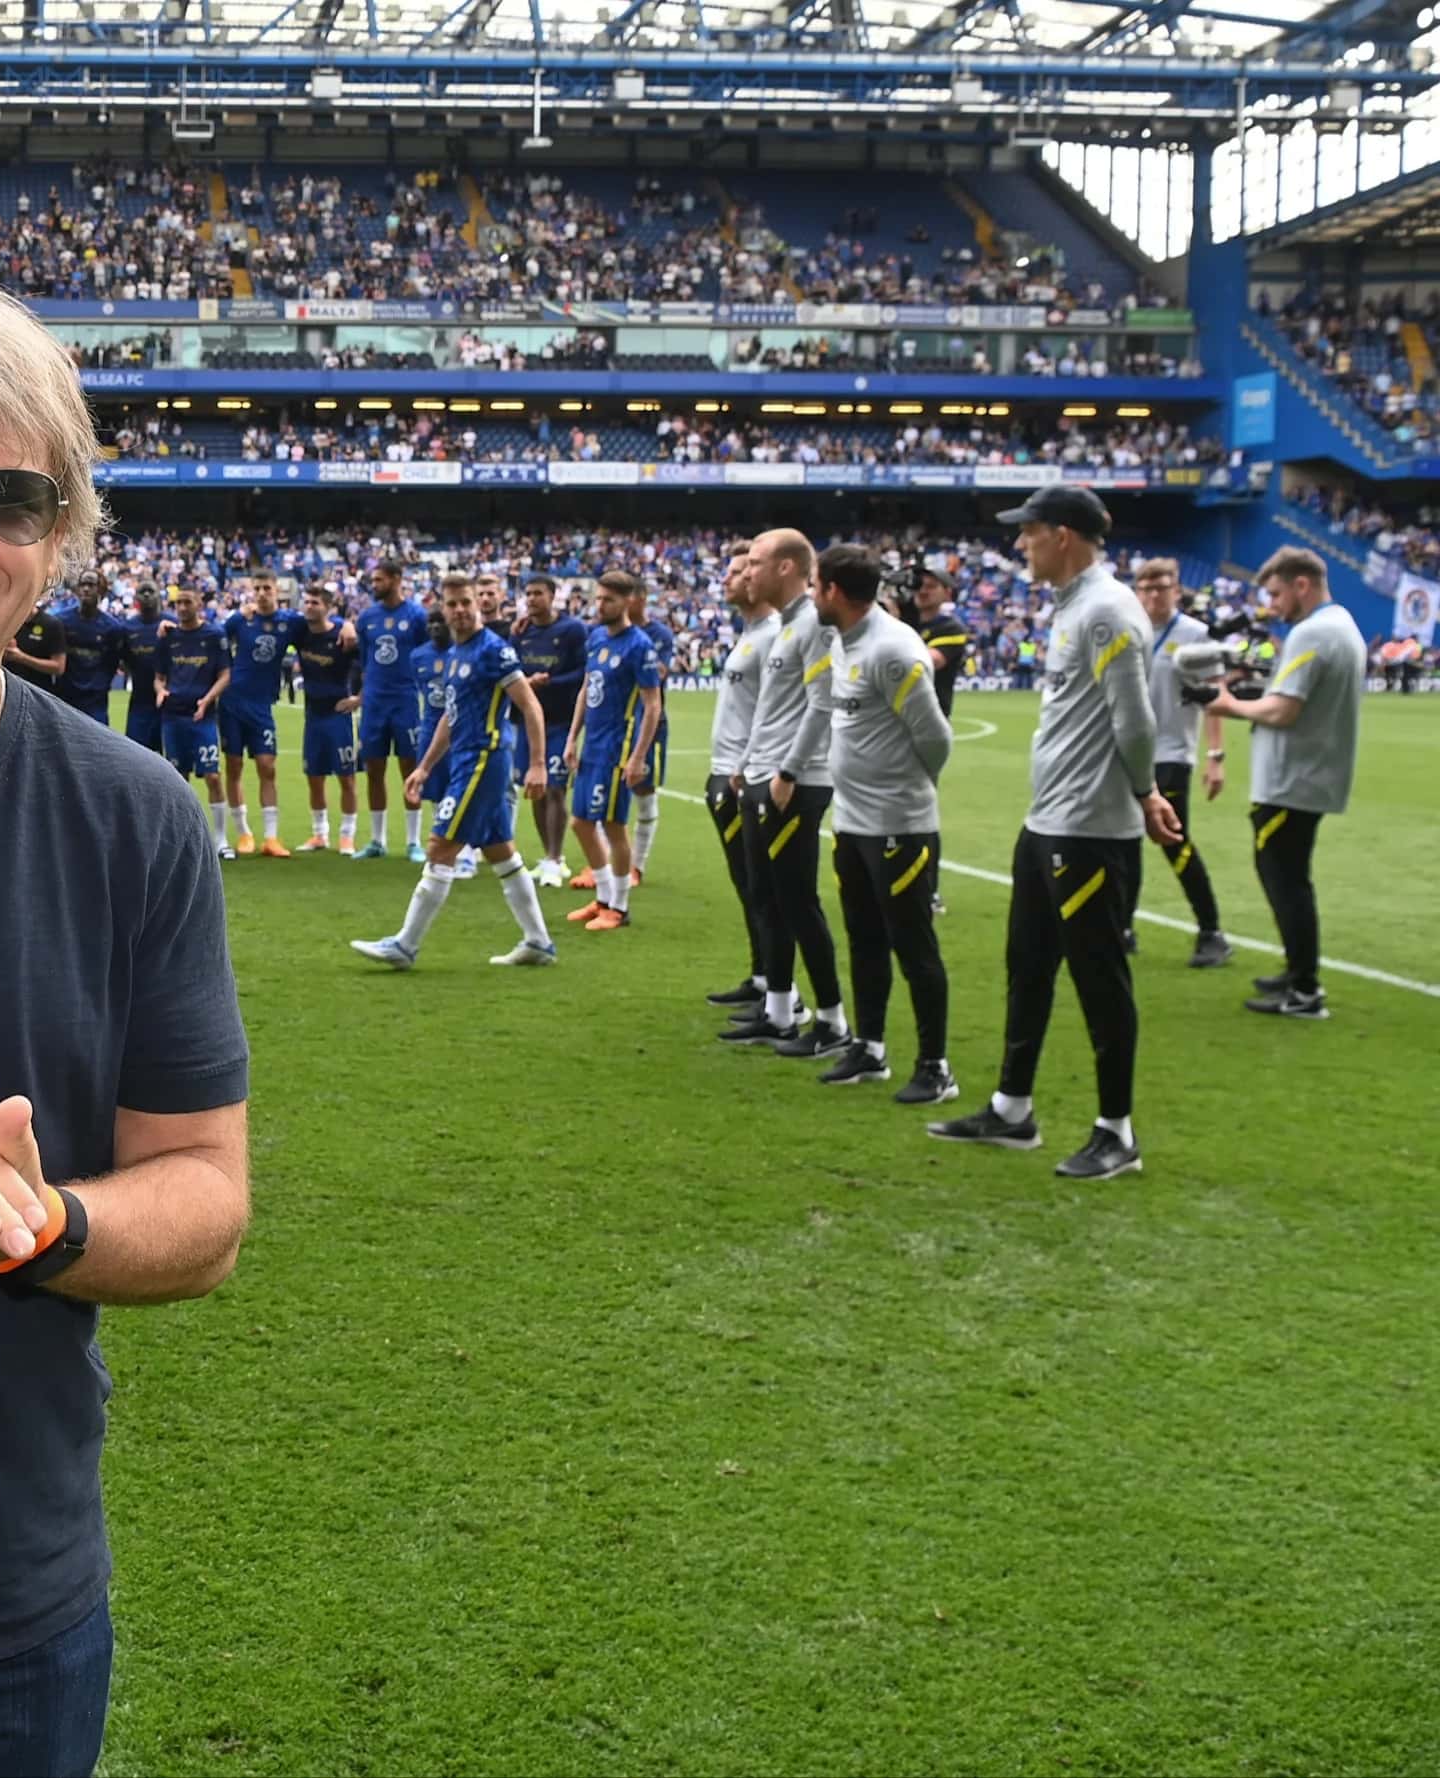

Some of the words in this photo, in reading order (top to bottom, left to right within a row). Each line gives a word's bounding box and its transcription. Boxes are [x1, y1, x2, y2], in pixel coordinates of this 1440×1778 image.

[310, 304, 356, 316] MALTA
[79, 373, 123, 387] HELSEA
[127, 374, 145, 387] FC
[198, 744, 219, 763] 22
[338, 746, 354, 763] 10
[591, 783, 605, 806] 5
